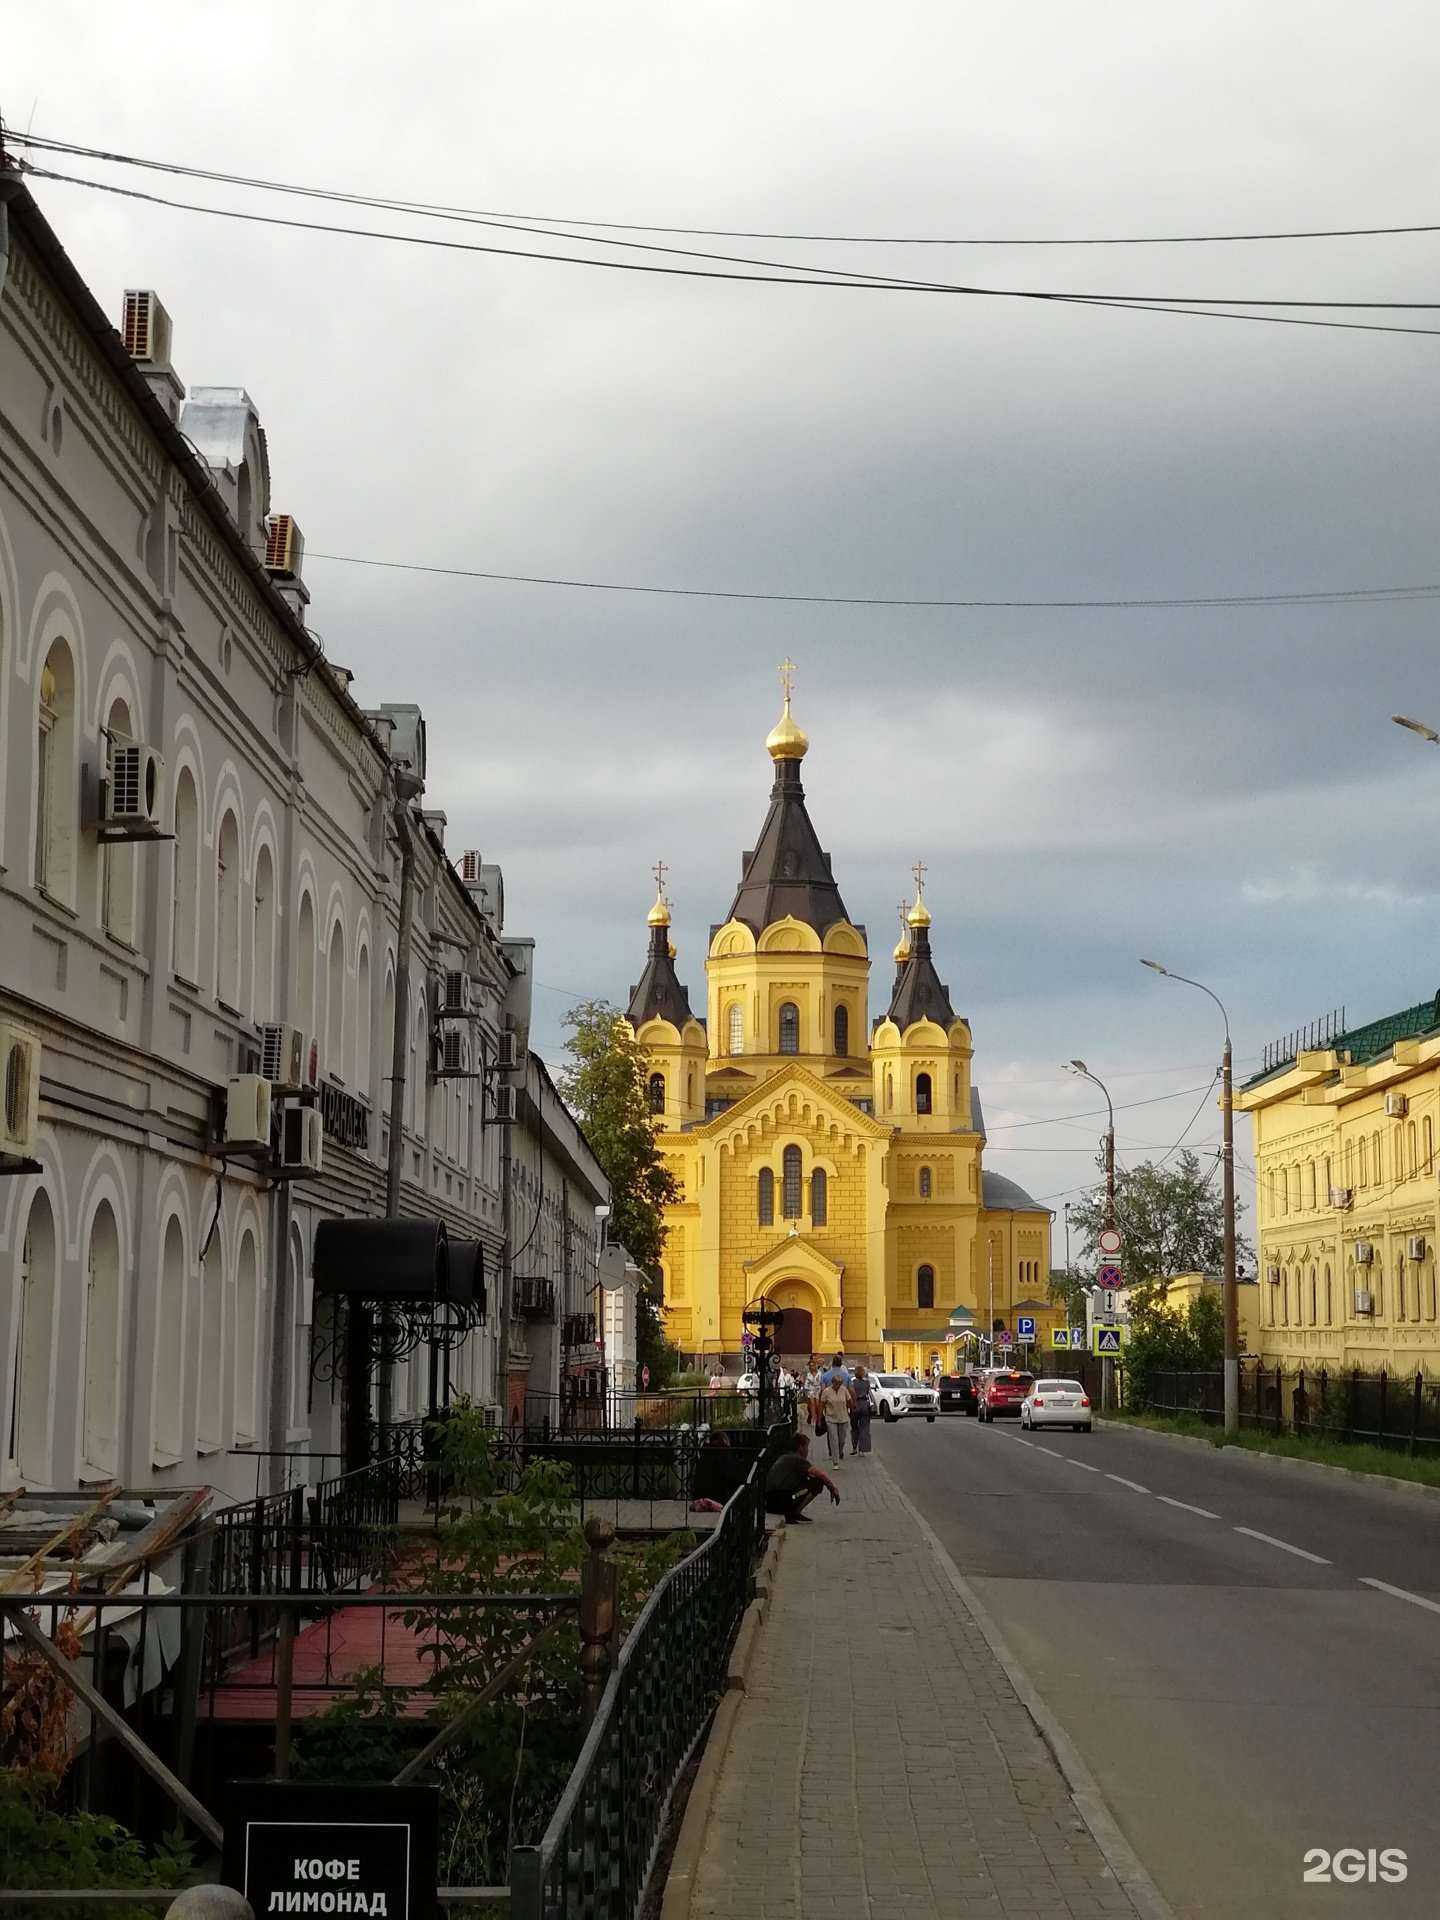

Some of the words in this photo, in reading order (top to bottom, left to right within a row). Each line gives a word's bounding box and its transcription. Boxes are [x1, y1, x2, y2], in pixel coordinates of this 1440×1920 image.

[1022, 1319, 1032, 1333] P
[293, 1859, 360, 1880] КОФЕ
[268, 1891, 388, 1917] ЛИМОНАД
